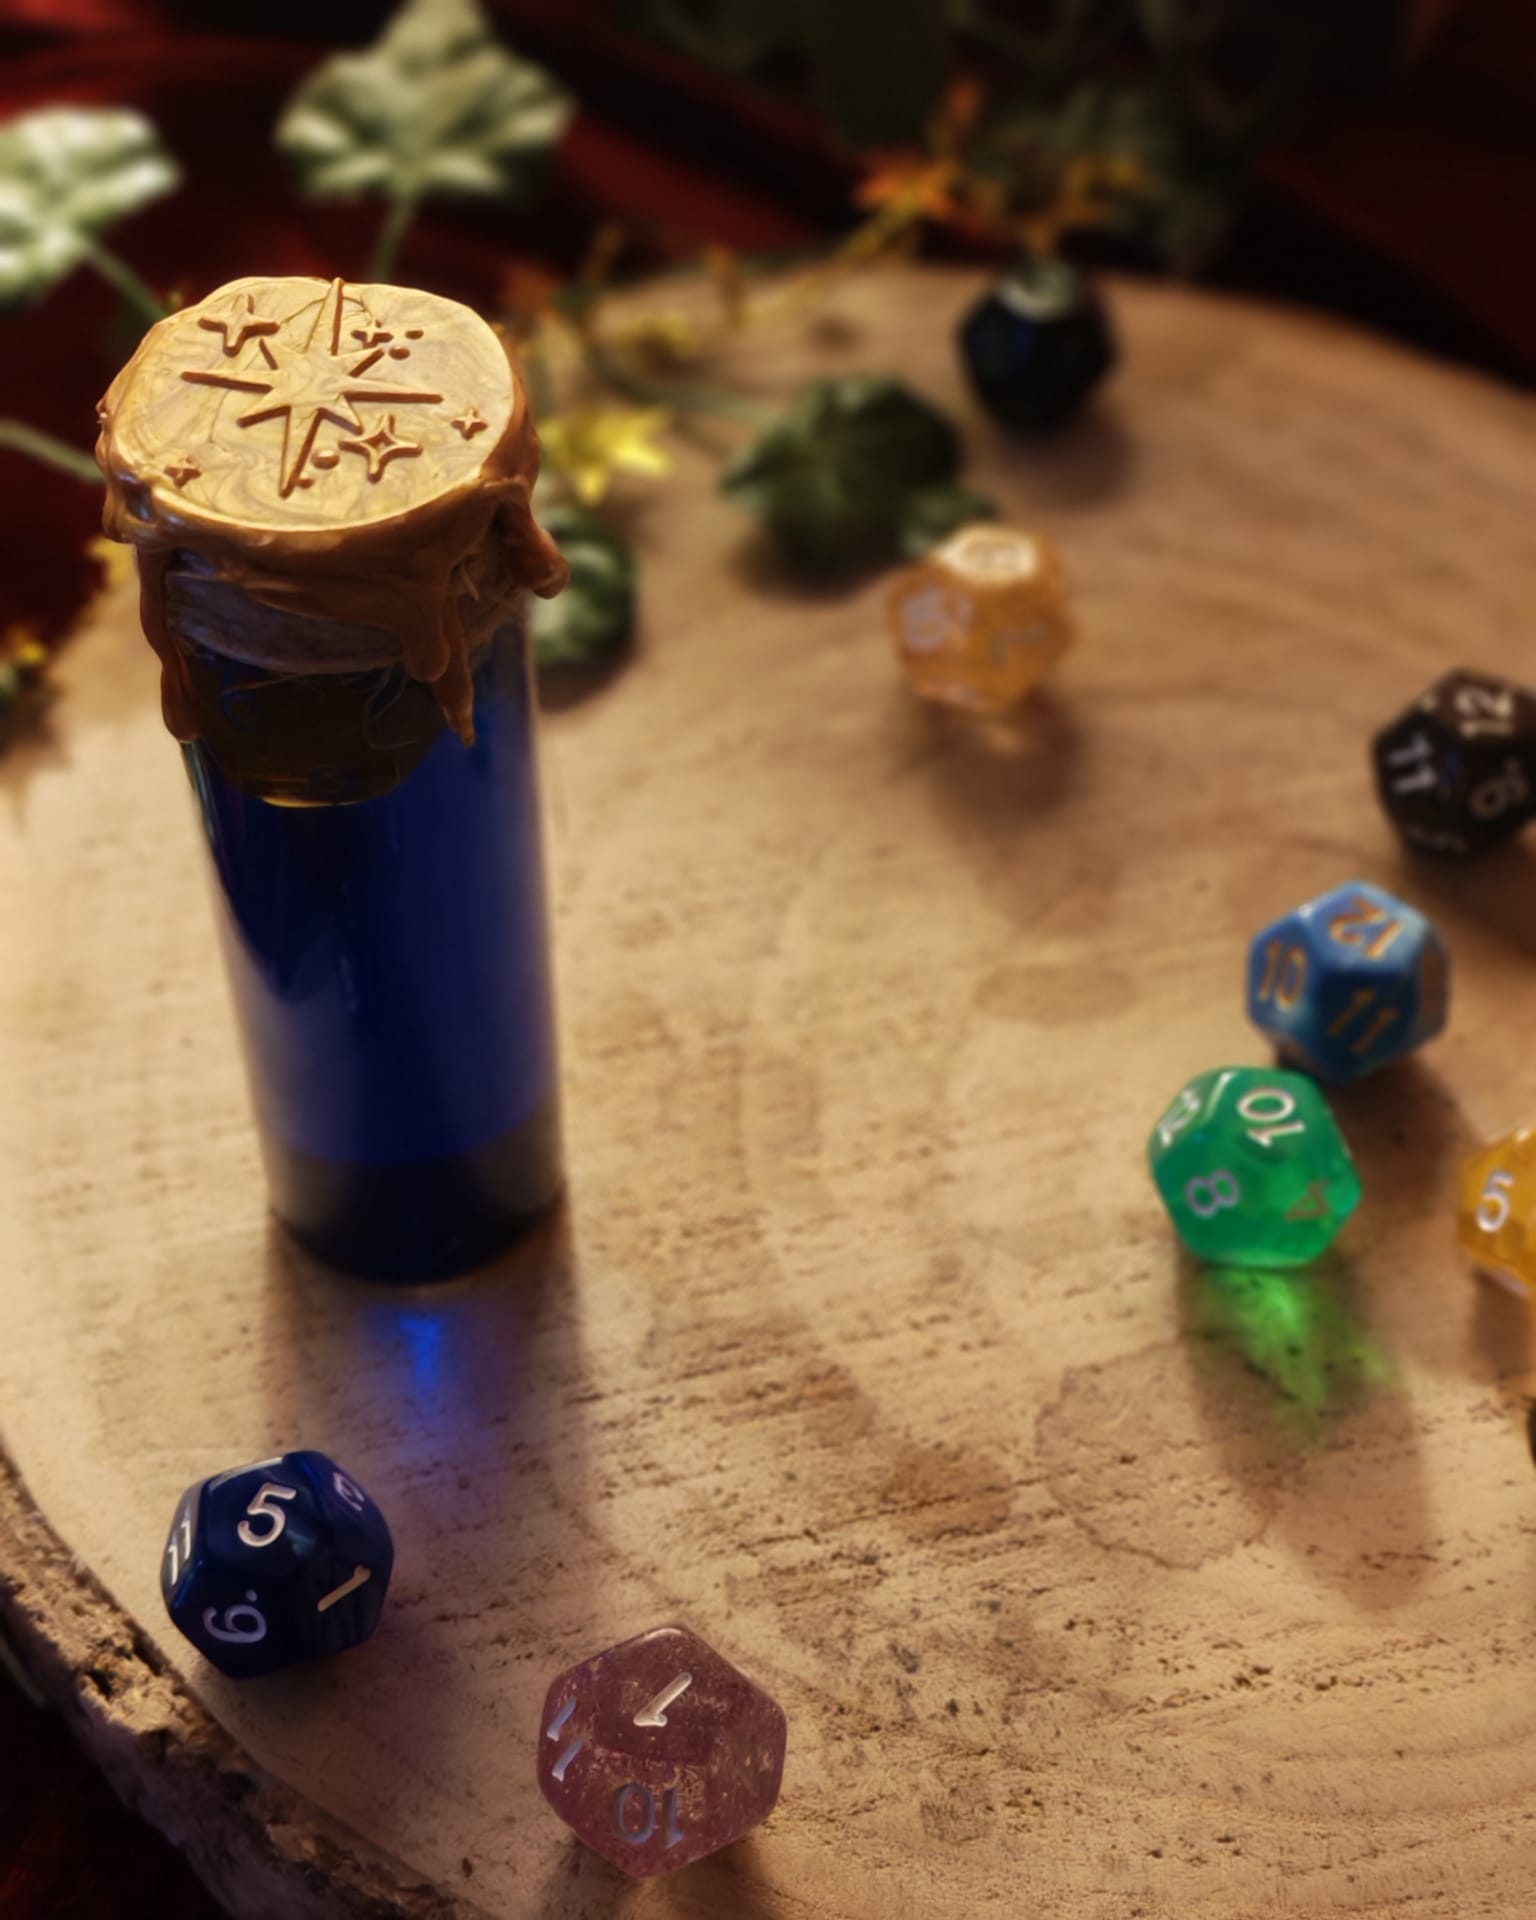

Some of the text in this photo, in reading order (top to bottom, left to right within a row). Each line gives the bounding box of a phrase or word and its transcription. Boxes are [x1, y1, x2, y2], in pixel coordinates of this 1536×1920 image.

[1328, 894, 1404, 959] 12
[1257, 935, 1308, 1010] 10
[1236, 1086, 1306, 1147] 10
[1185, 1168, 1241, 1219] 8
[1477, 1168, 1516, 1232] 5
[237, 1482, 297, 1547] 5
[317, 1564, 371, 1613] 1
[614, 1783, 685, 1848] 10
